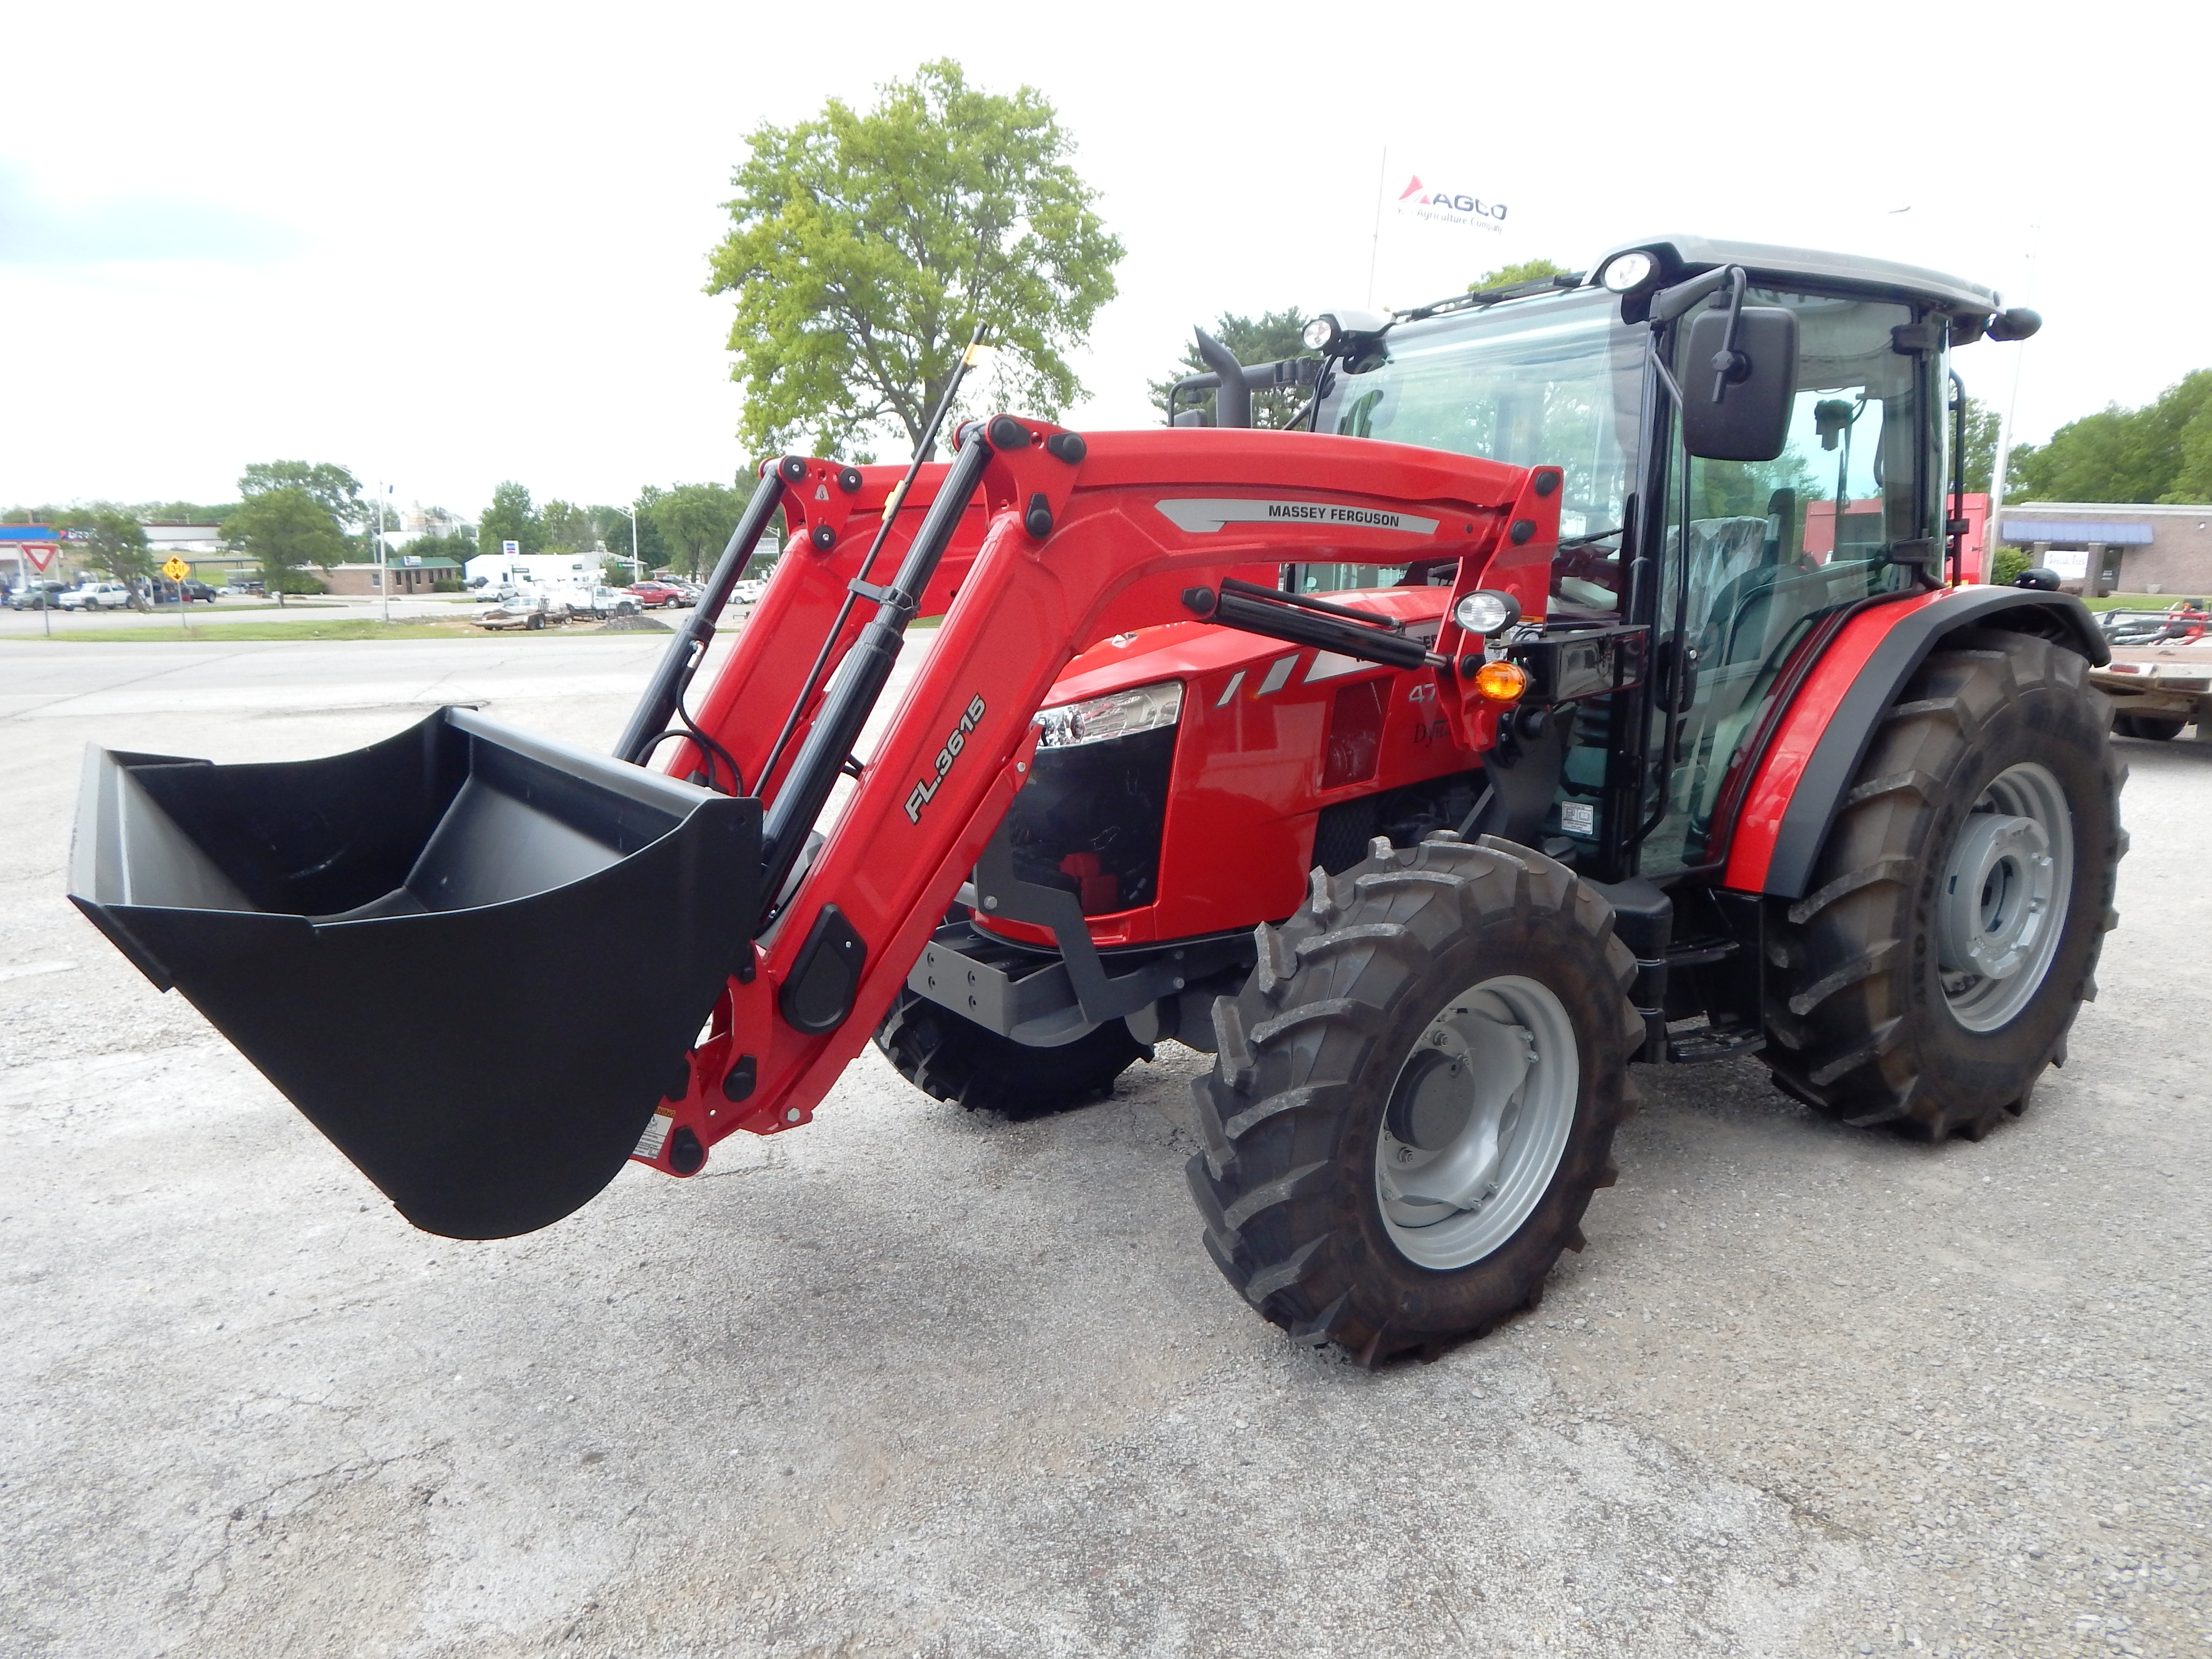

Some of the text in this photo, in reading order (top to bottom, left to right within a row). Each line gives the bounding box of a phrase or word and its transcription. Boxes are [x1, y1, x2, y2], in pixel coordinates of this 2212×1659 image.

[1433, 193, 1508, 220] AGCO
[1417, 208, 1468, 224] Agriculture
[1470, 217, 1503, 235] Company
[1268, 505, 1400, 527] MASSEY FERGUSON
[903, 692, 986, 825] FL.3615
